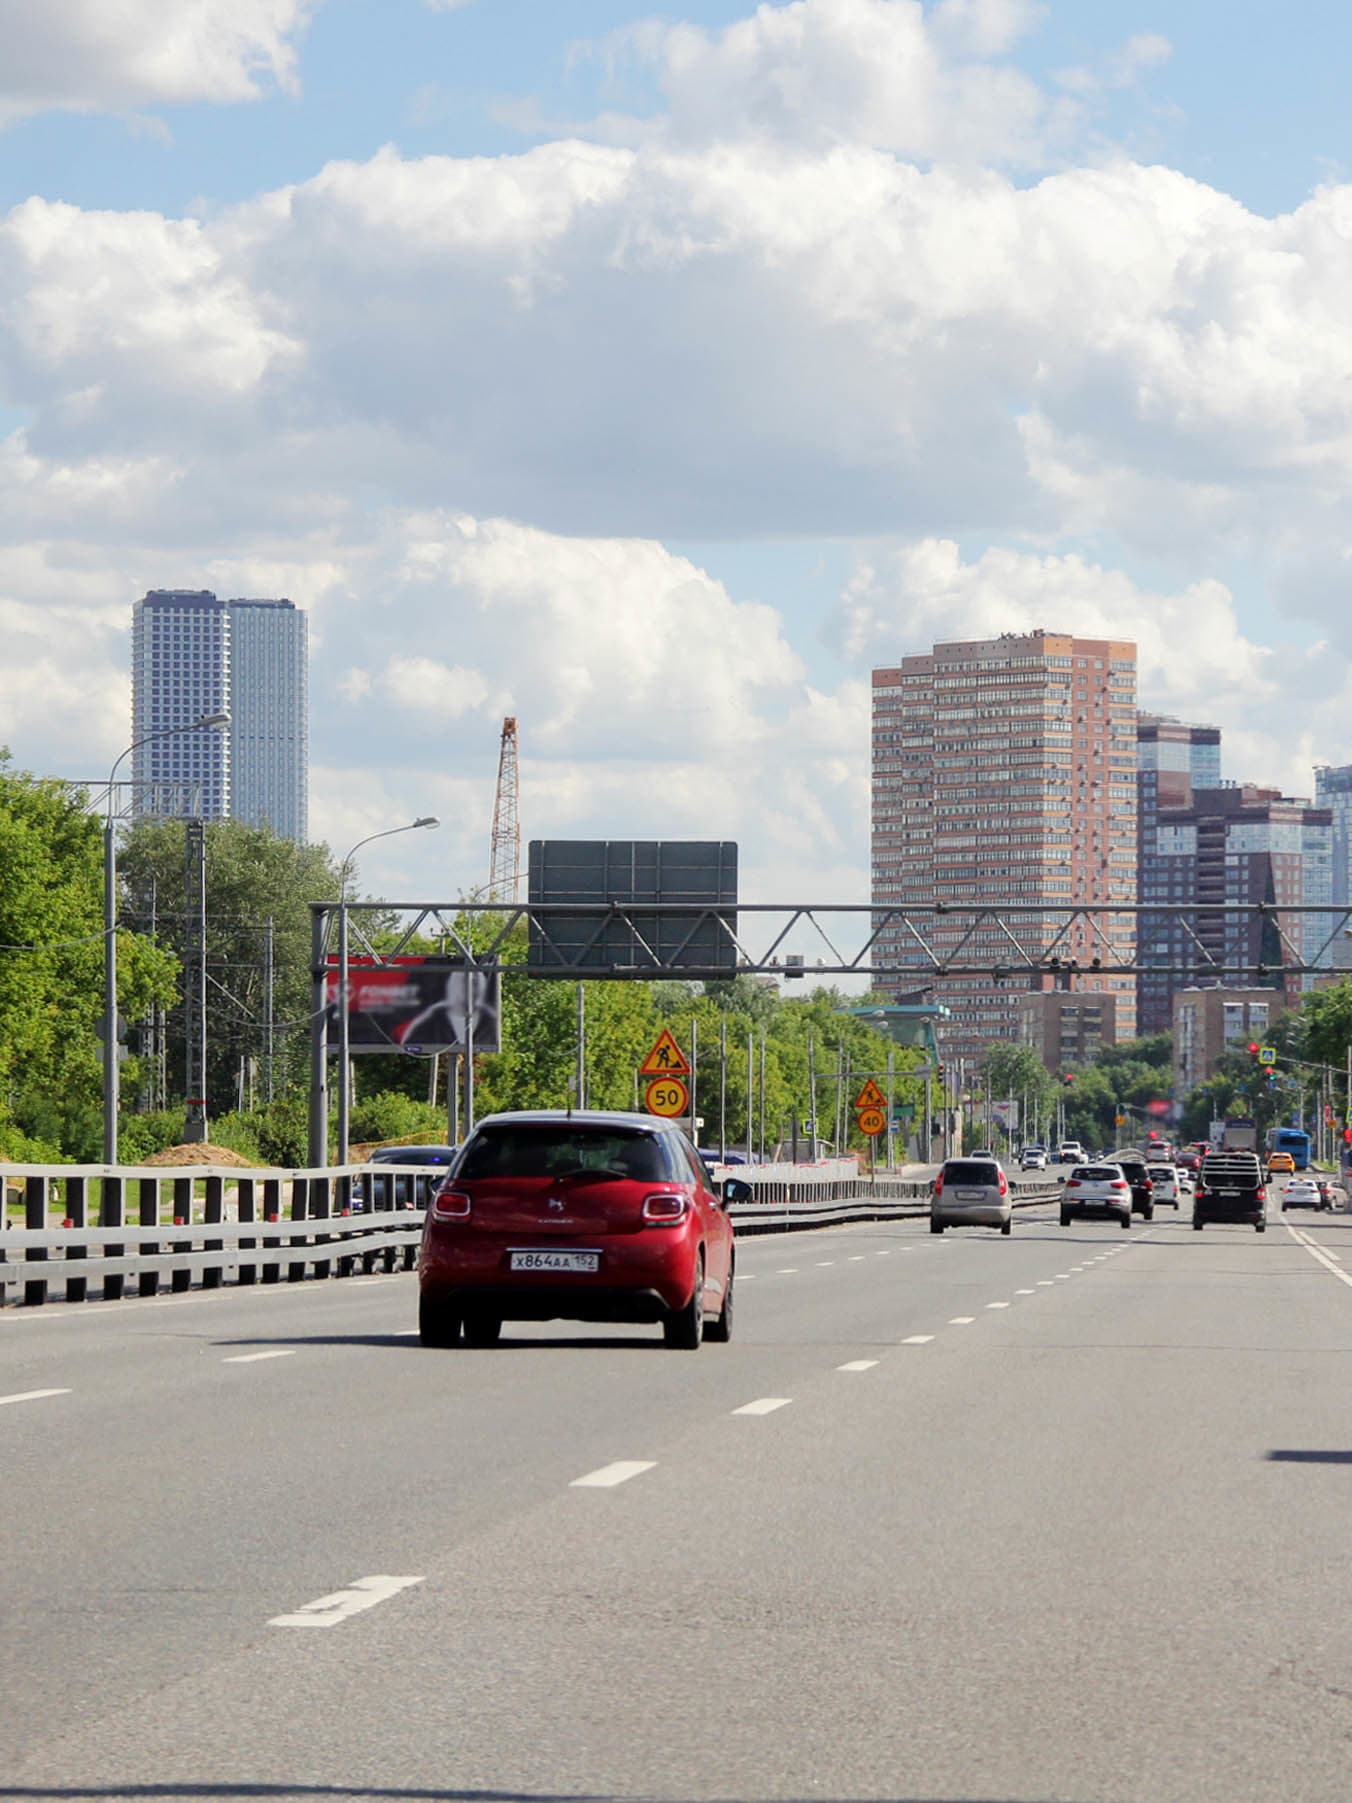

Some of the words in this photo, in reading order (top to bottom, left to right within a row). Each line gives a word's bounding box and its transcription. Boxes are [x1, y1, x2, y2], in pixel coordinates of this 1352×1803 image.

[655, 1089, 679, 1106] 50
[863, 1116, 880, 1126] 40
[574, 1255, 595, 1266] 152
